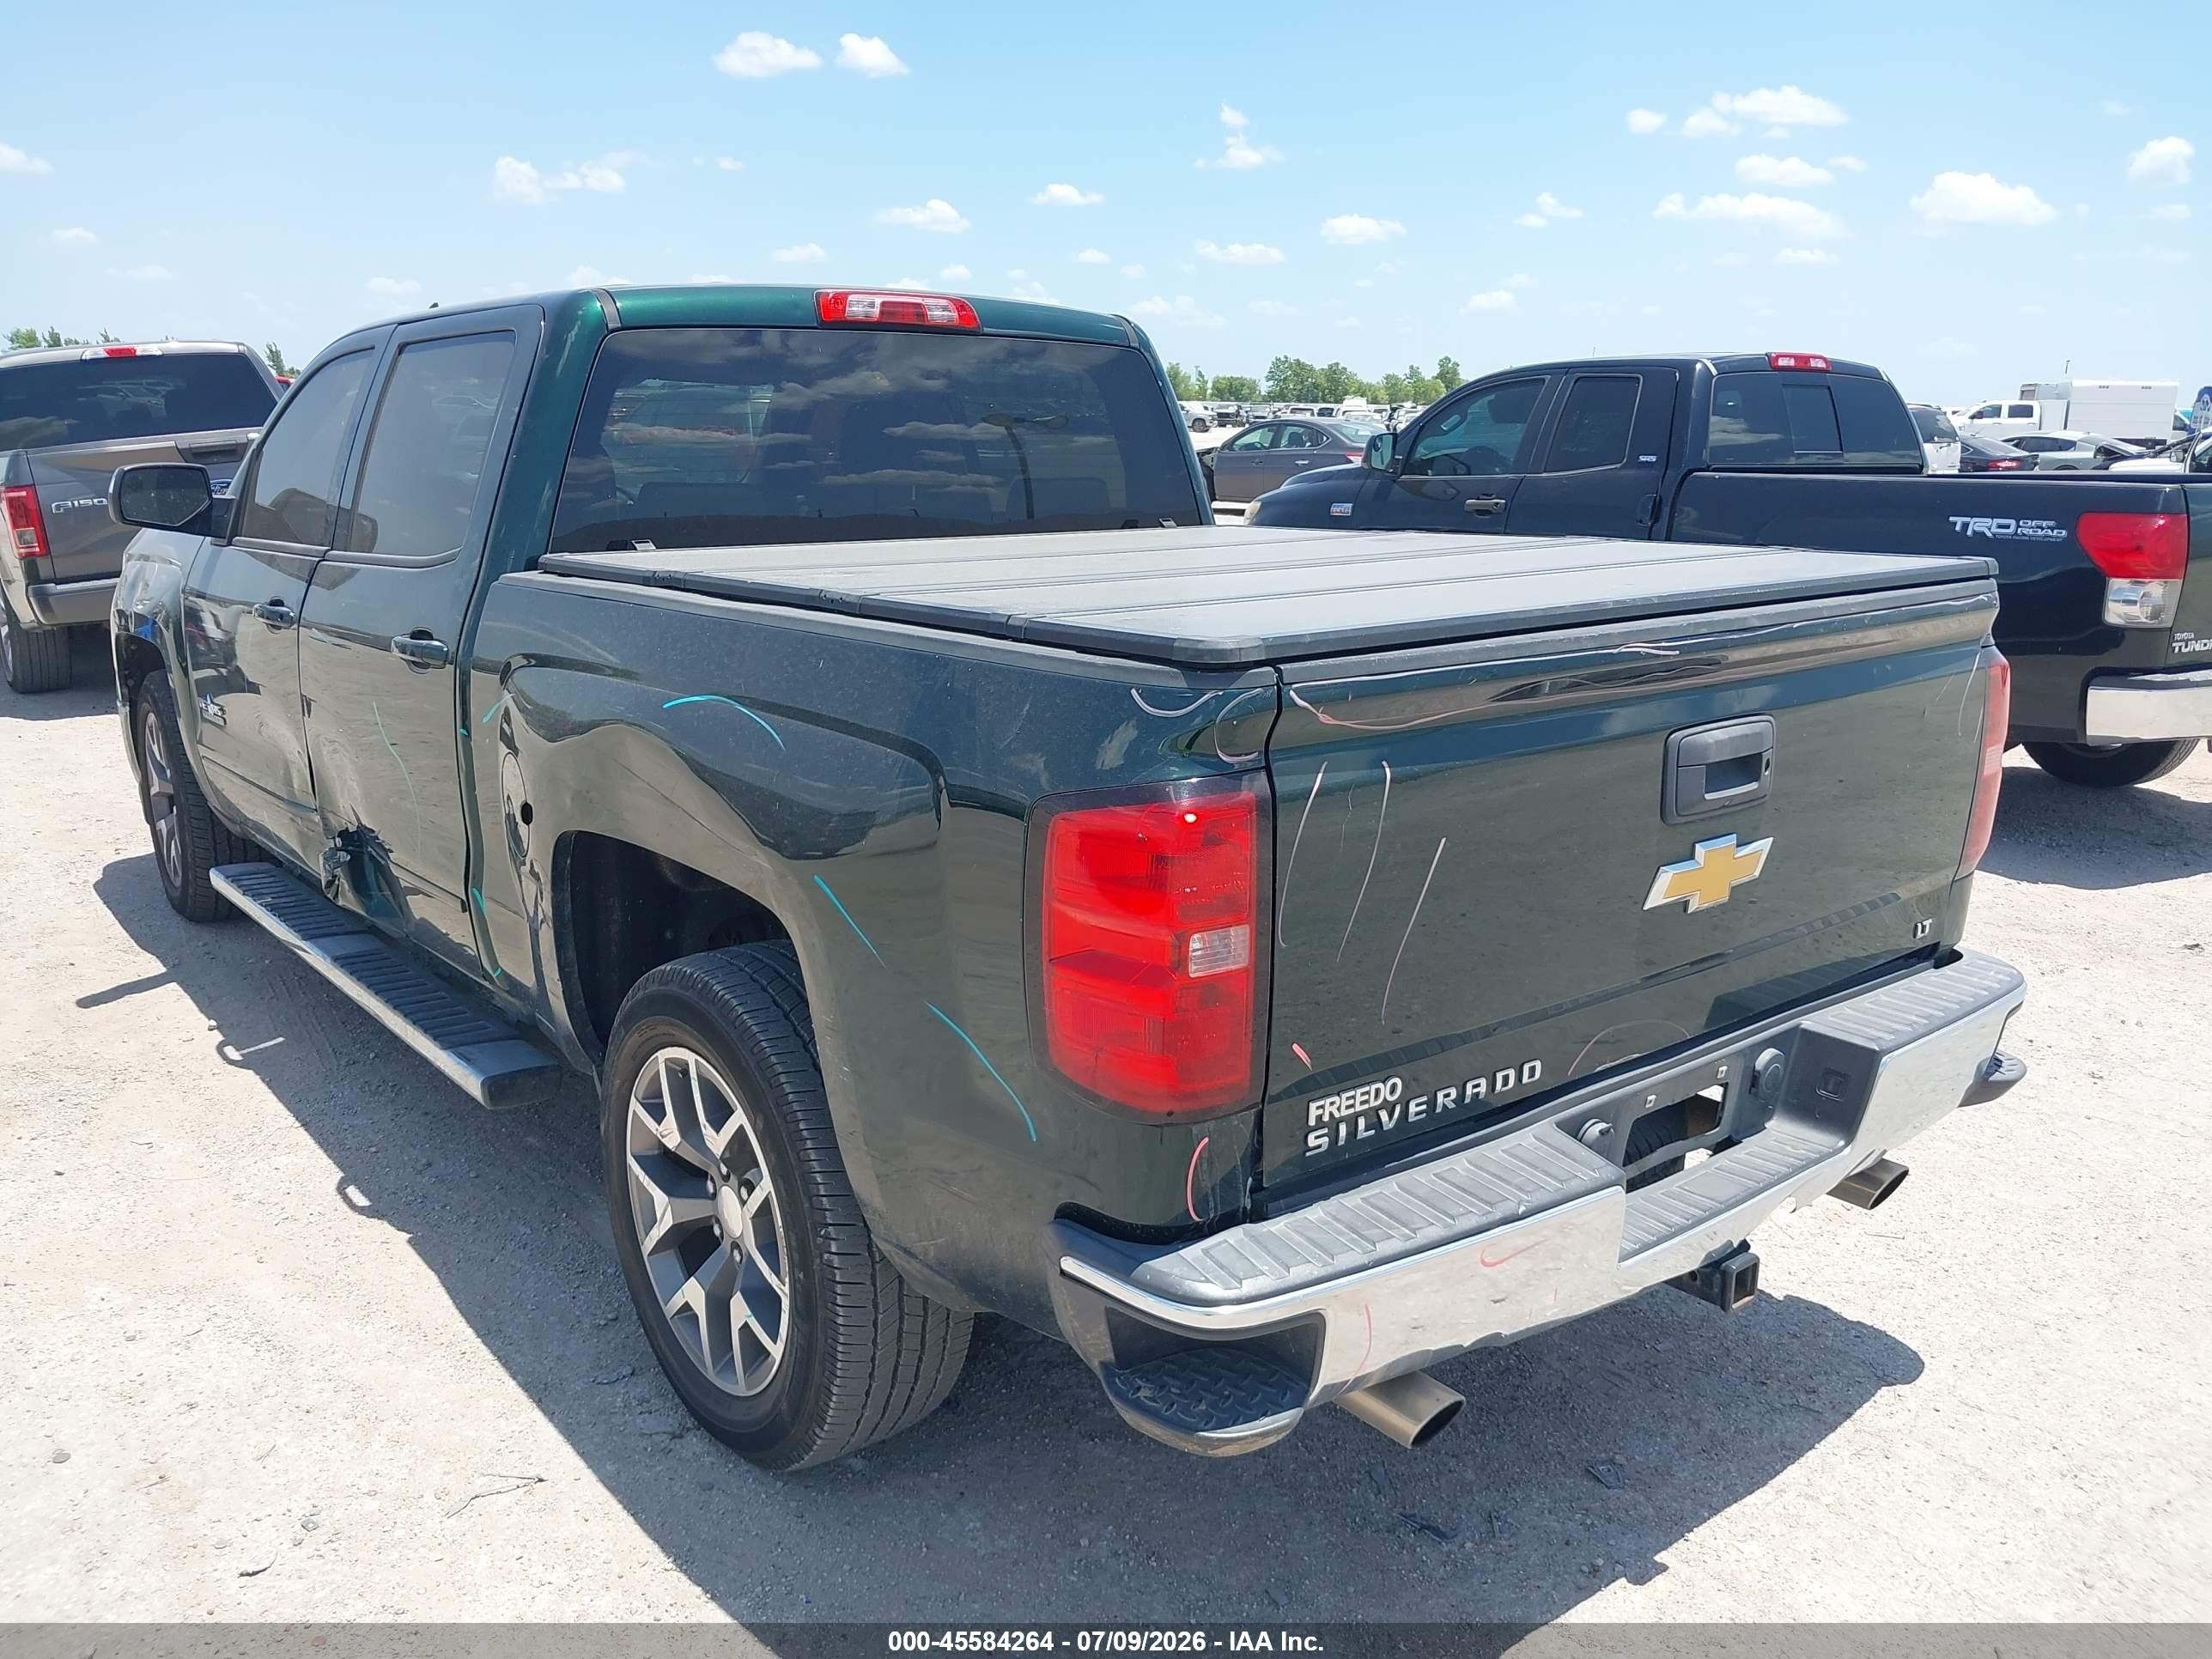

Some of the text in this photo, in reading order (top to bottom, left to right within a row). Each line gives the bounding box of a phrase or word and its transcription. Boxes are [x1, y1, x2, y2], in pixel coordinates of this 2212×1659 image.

[1948, 516, 2017, 538] TRD
[2017, 527, 2067, 538] ROAD
[2019, 520, 2057, 528] OFF
[2173, 632, 2195, 641] TOYOTA
[1916, 918, 1933, 939] LT
[1304, 1059, 1542, 1157] SILVERADO
[1307, 1075, 1402, 1127] FREEDO
